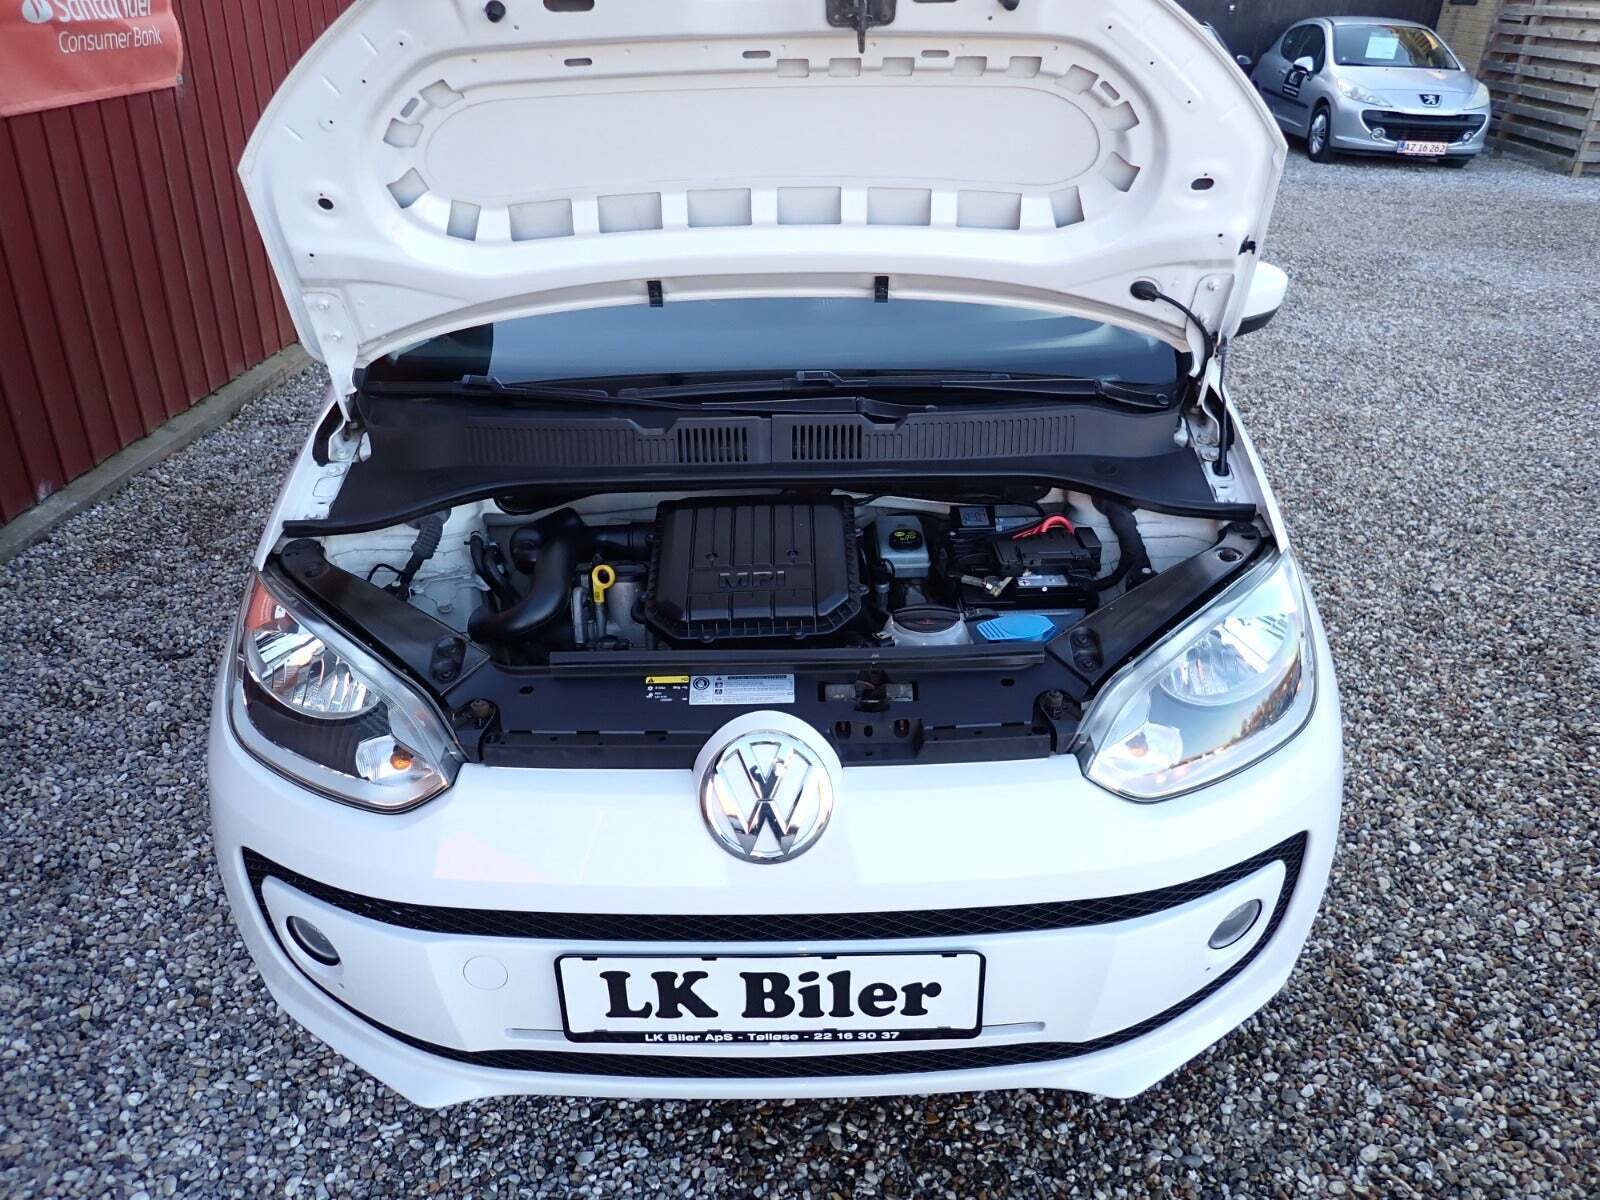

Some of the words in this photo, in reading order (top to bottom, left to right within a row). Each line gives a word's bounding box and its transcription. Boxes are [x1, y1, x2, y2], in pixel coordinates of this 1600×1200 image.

[58, 31, 131, 53] Consumer
[133, 26, 162, 47] Bank
[719, 570, 786, 589] MPI
[599, 970, 719, 1018] LK
[739, 969, 943, 1018] Biler
[645, 1033, 664, 1042] LK
[667, 1033, 701, 1042] Biler
[704, 1033, 733, 1043] ApS
[813, 1032, 832, 1040] 22
[836, 1032, 853, 1040] 16
[857, 1031, 876, 1040] 30
[881, 1031, 900, 1040] 37
